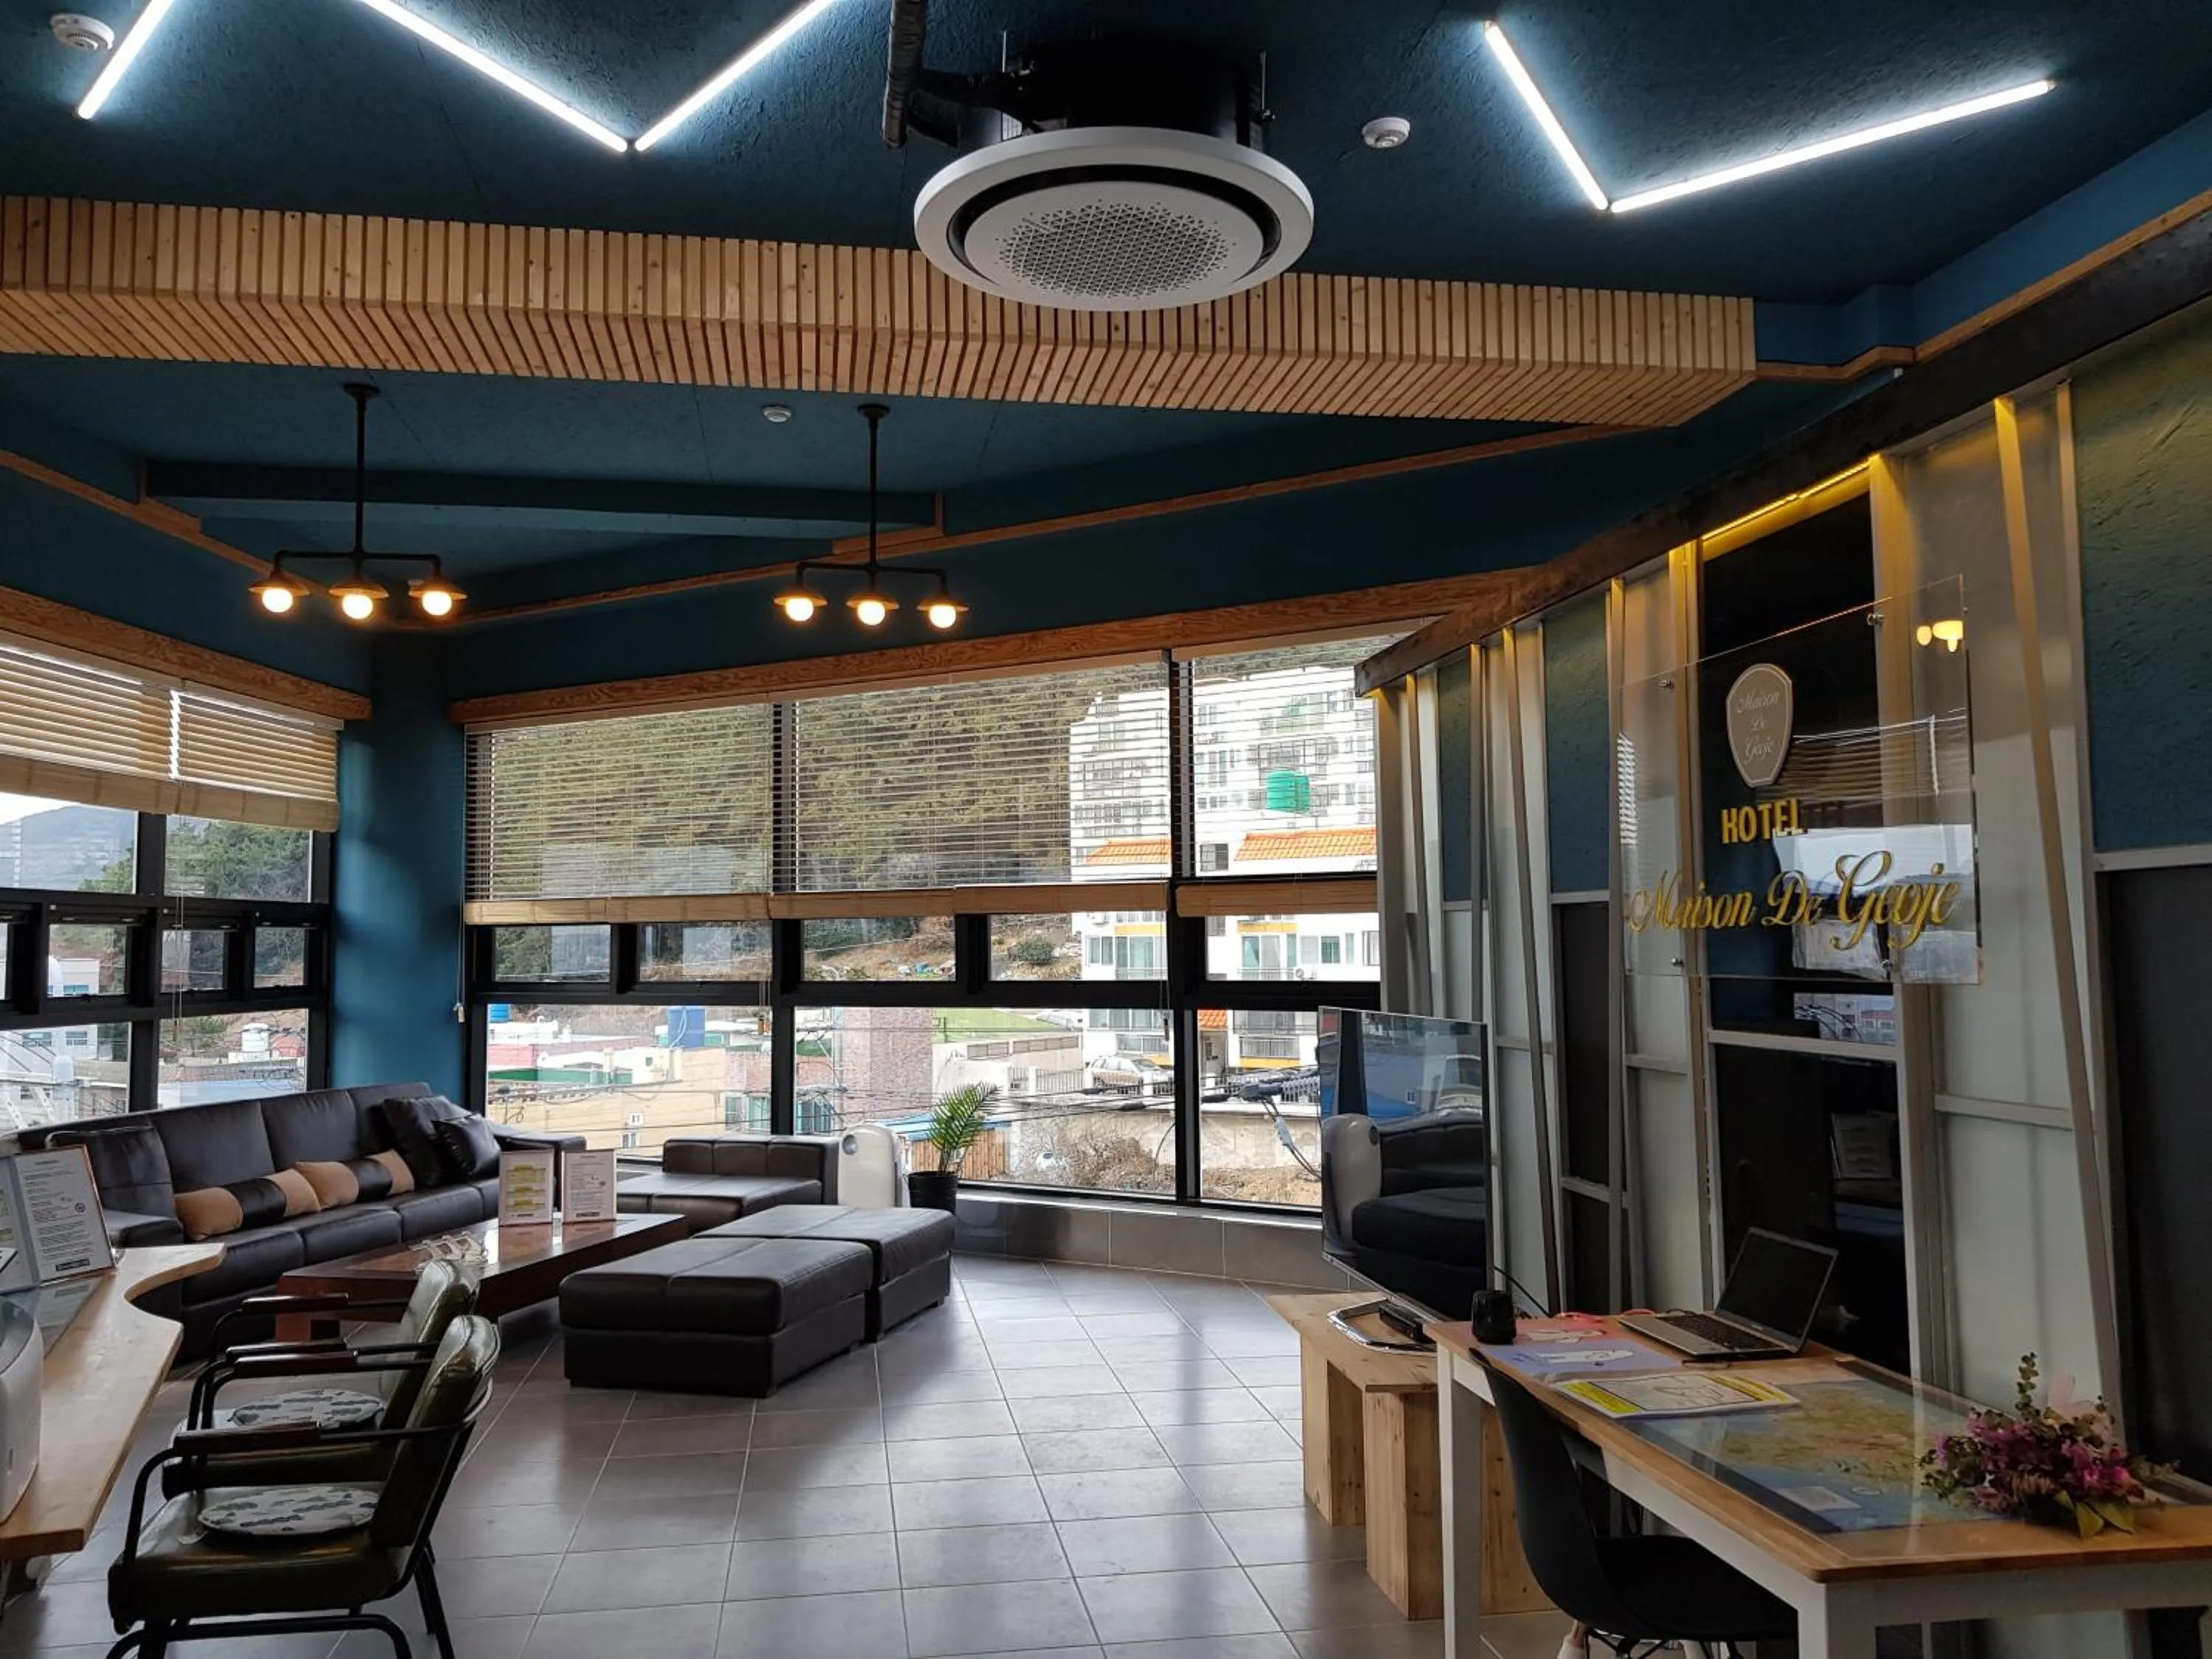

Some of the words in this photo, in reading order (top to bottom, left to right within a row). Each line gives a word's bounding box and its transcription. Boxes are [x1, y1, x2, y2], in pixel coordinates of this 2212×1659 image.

[1722, 799, 1804, 844] HOTEL
[1628, 869, 1755, 933] Maison
[1761, 870, 1823, 926] De
[1829, 850, 1962, 950] Geoje
